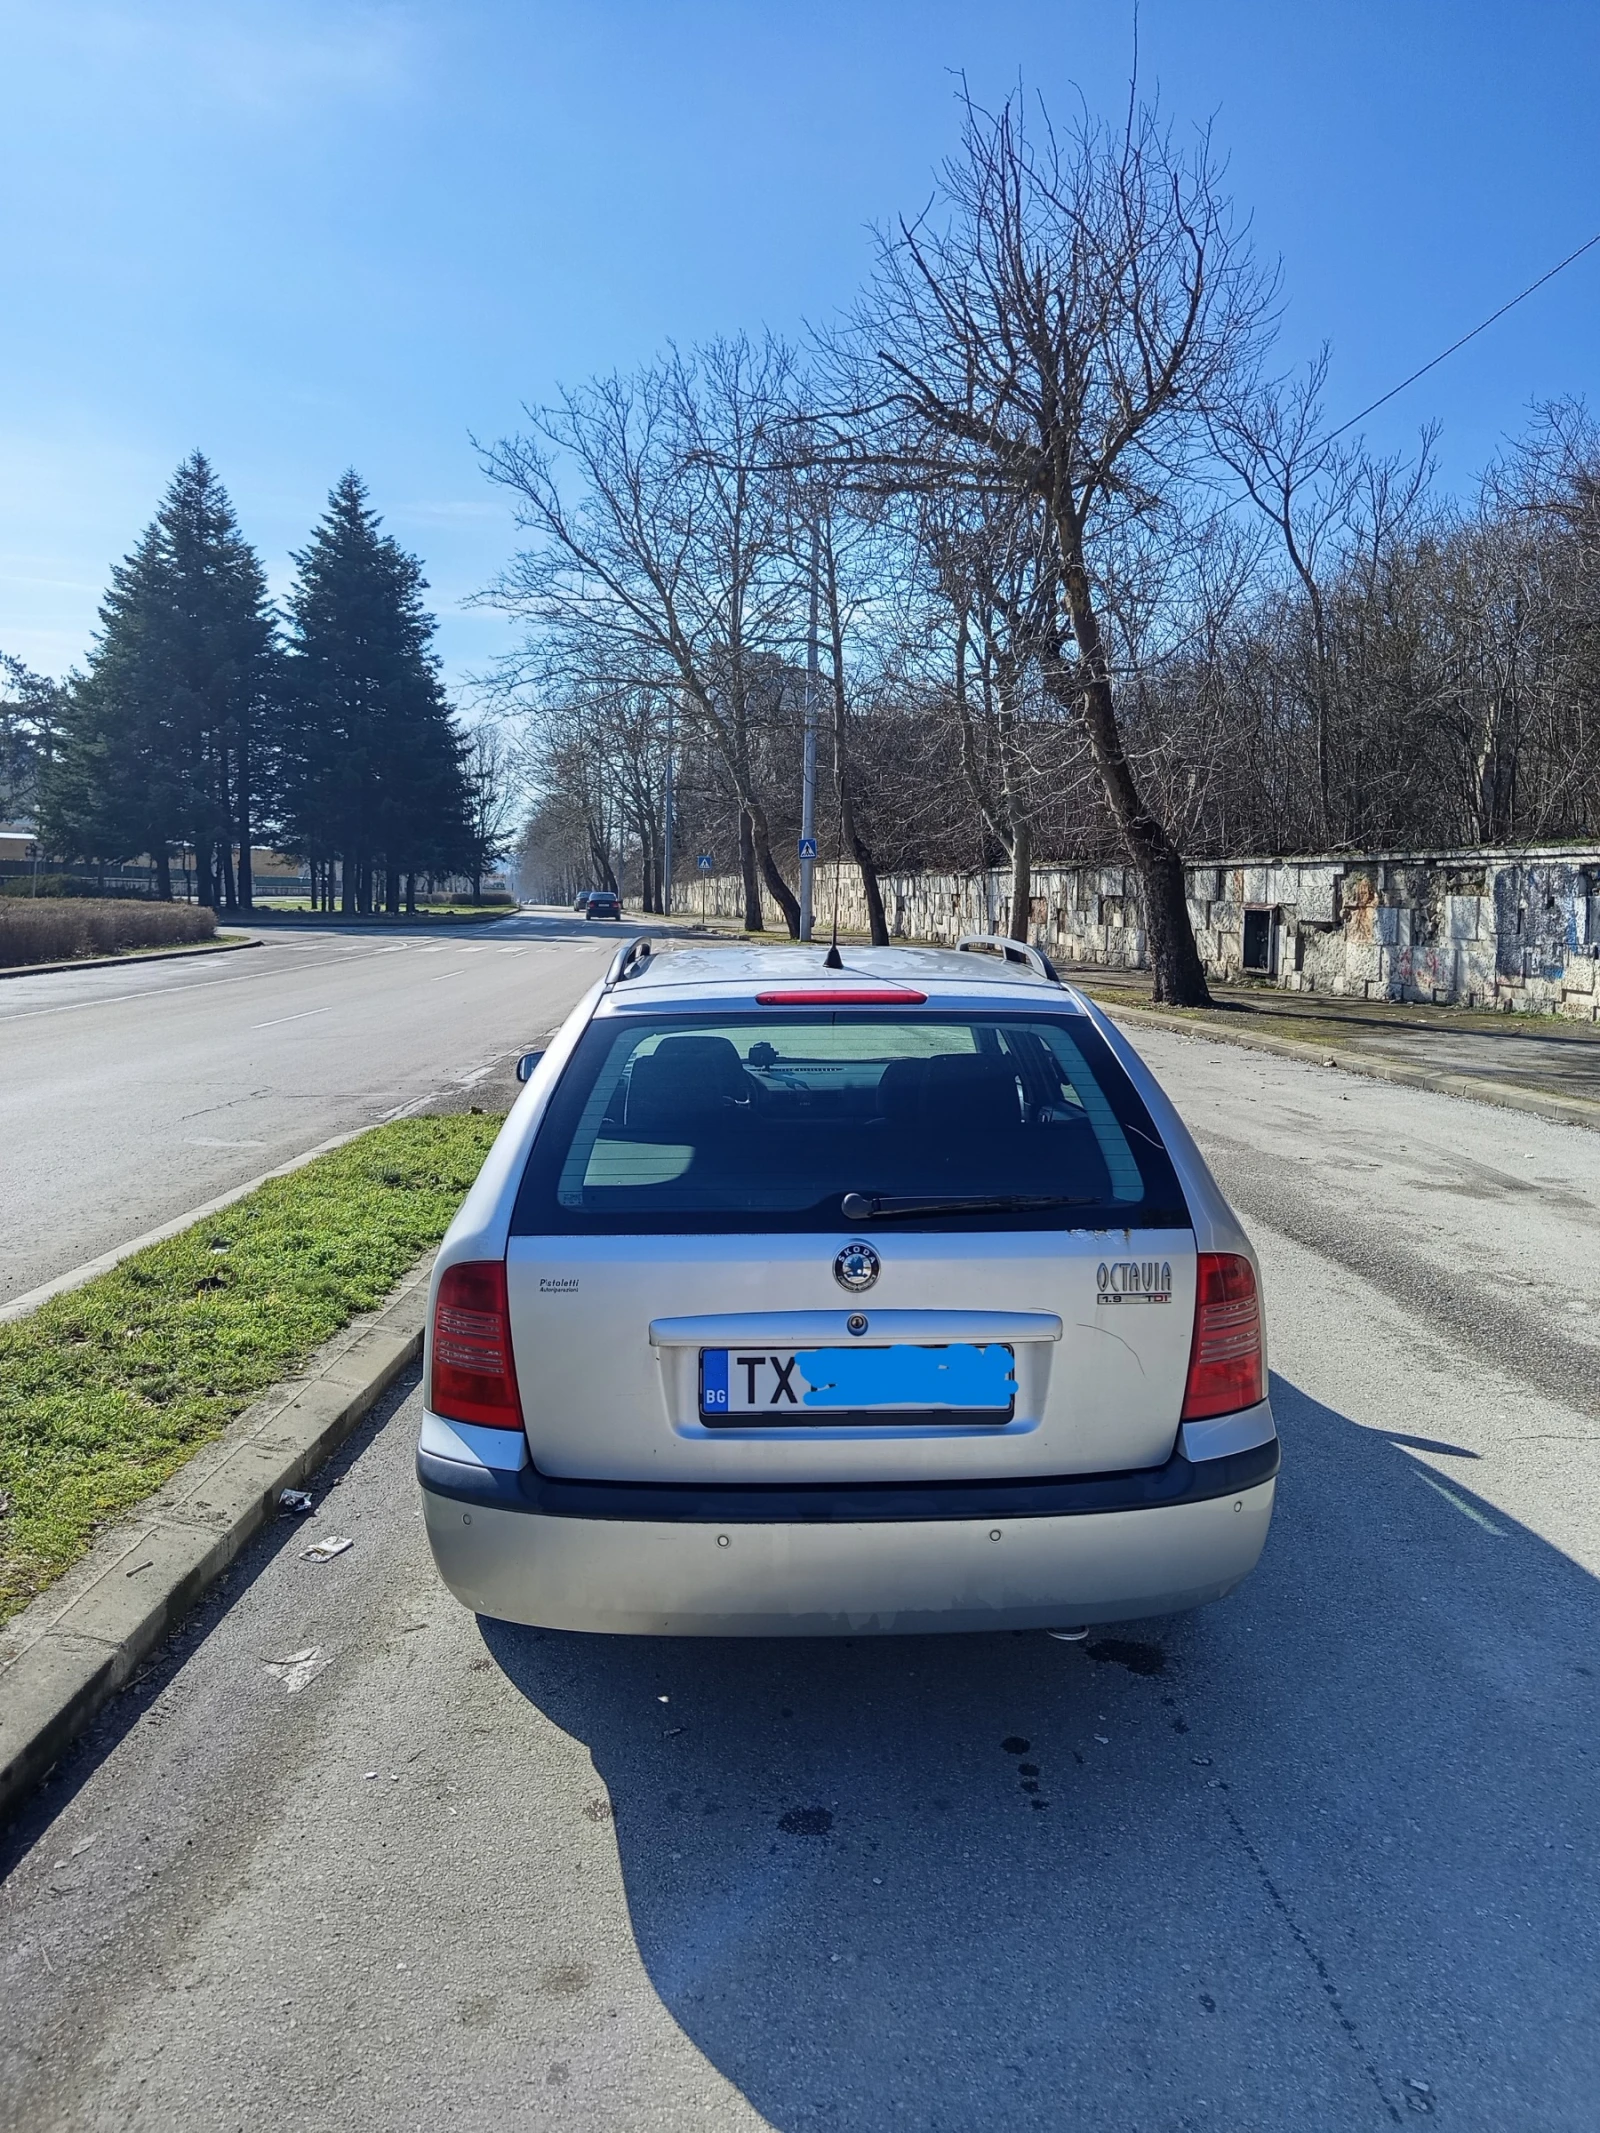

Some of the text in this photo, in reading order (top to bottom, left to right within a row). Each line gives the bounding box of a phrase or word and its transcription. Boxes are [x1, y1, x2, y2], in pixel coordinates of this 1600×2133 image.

[539, 1278, 579, 1287] Pistoletti
[1096, 1262, 1172, 1292] OCTAVIA
[1101, 1295, 1122, 1303] 1.9
[706, 1389, 726, 1404] BG
